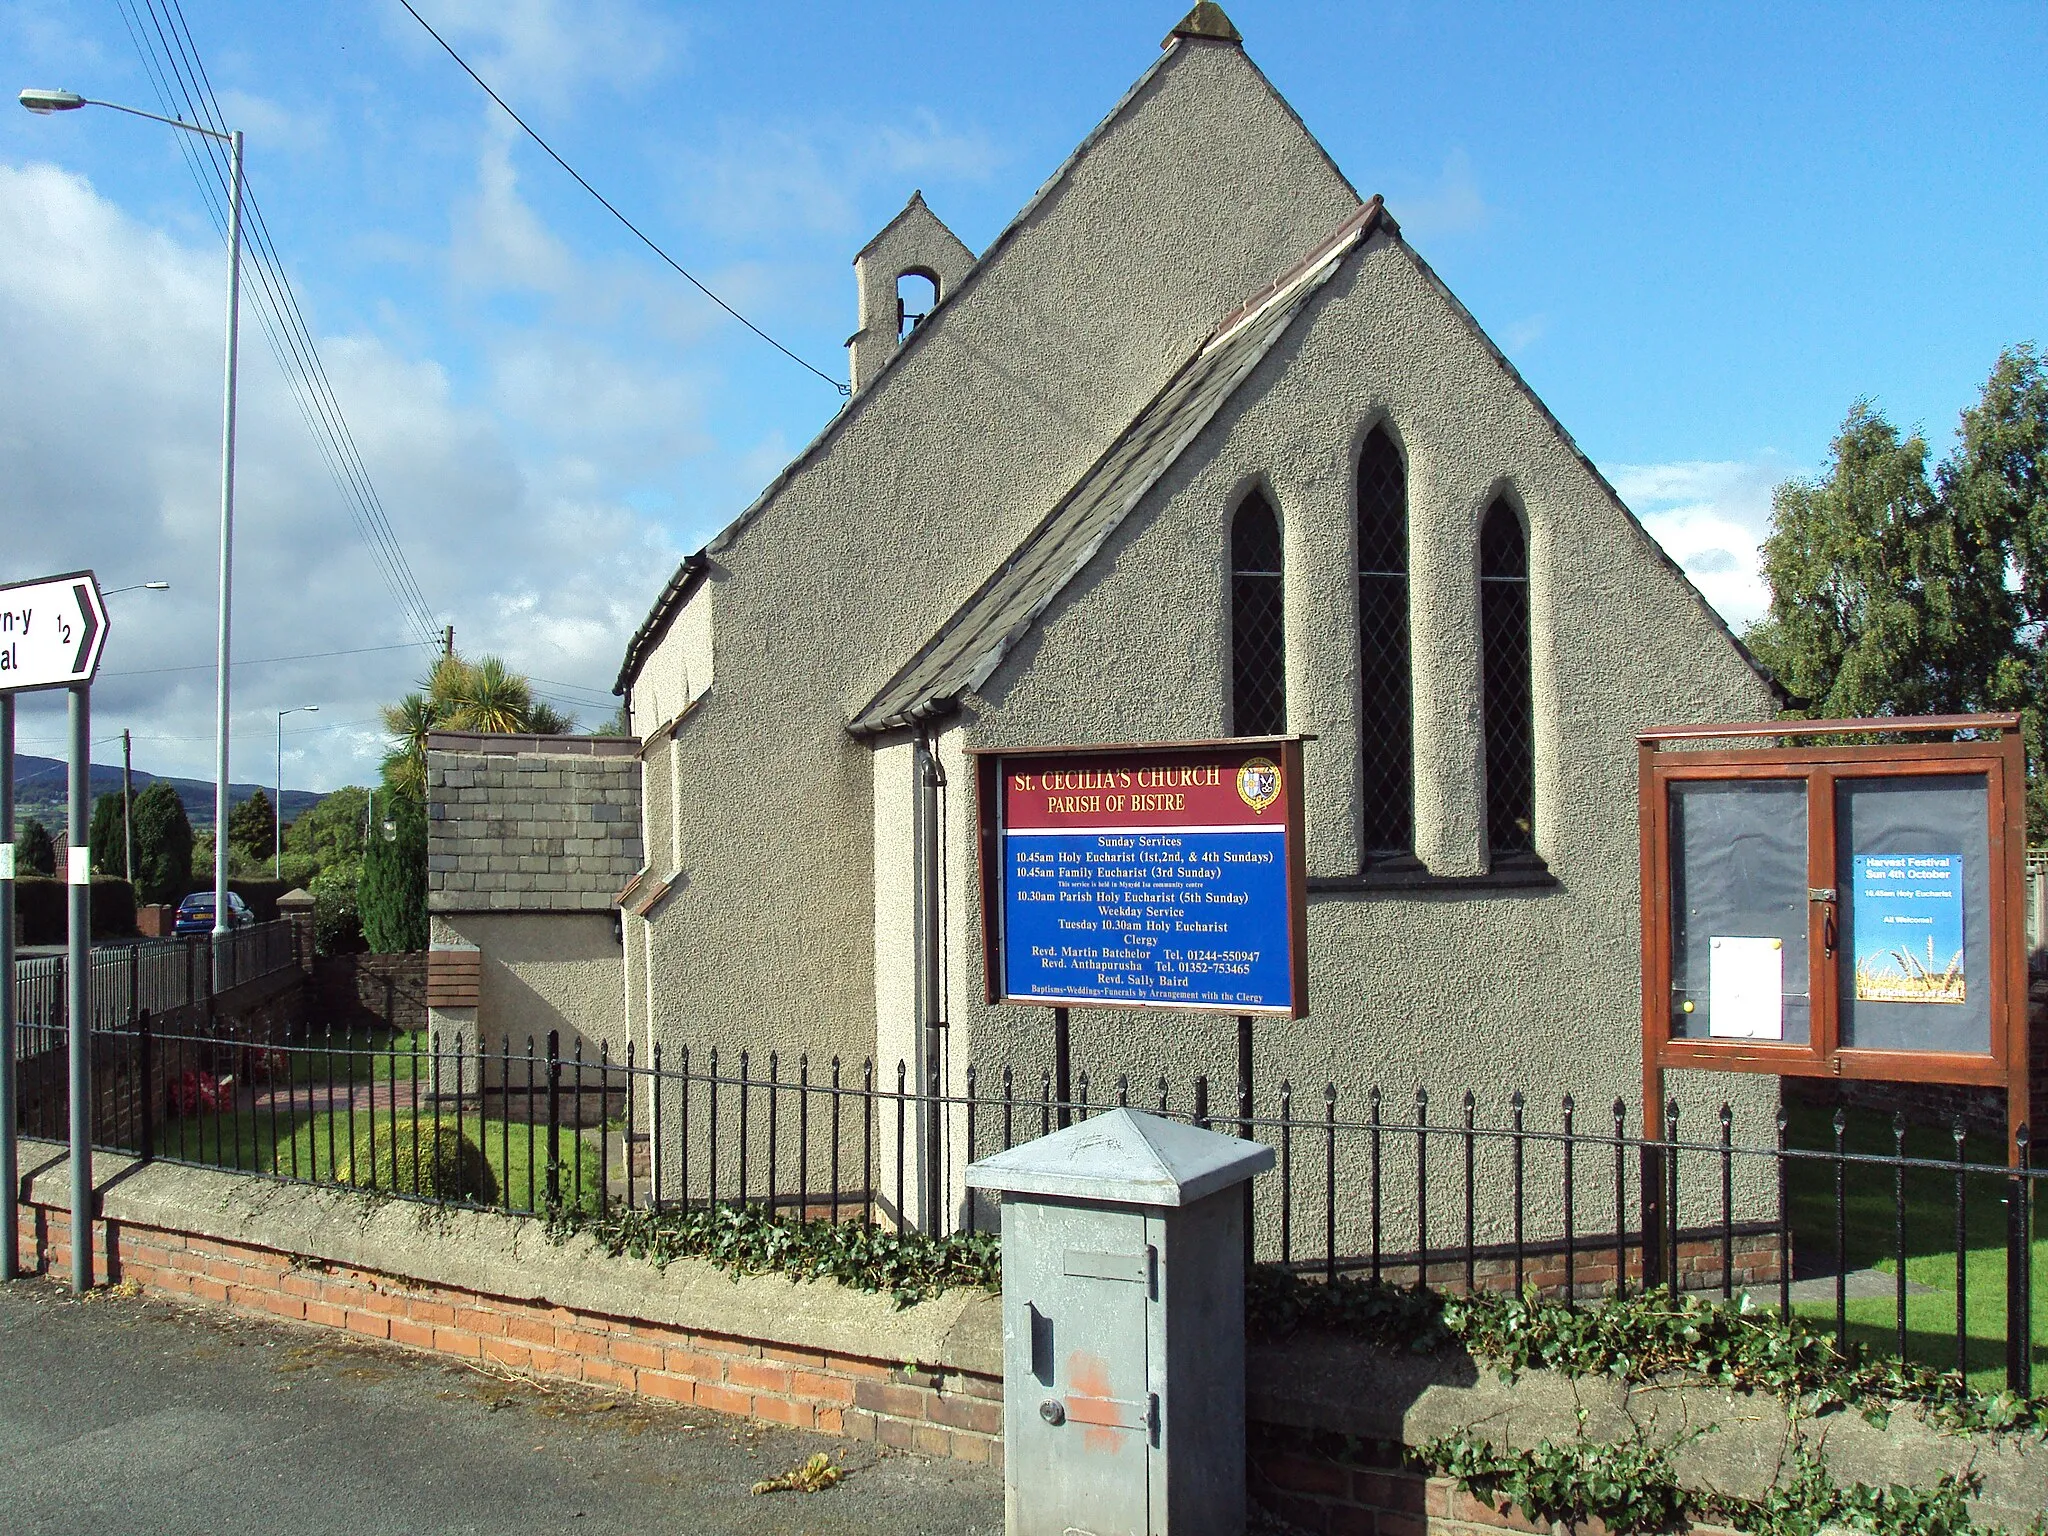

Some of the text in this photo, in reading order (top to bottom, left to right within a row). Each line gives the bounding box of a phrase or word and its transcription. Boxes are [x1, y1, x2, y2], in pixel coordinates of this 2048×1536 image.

[0, 608, 32, 636] n-y
[1015, 772, 1036, 791] St.
[1041, 768, 1131, 790] CECILIA'S
[1137, 765, 1221, 788] CHURCH
[1048, 793, 1185, 813] PARISH OF BISTRE
[1098, 835, 1182, 848] Sunday Services
[1016, 851, 1274, 864] 10.45am Holy Eucharist (1st,2nd, & 4th Sundays)
[1866, 858, 1950, 867] Harvest Festival
[1017, 866, 1222, 879] 10.45am Family Eucharist (3rd Sunday)
[1865, 870, 1951, 879] Sun 4th October
[1152, 881, 1184, 889] community
[1017, 891, 1249, 905] 10.30am Parish Holy Eucharist (5th Sunday)
[1098, 906, 1184, 918] Weekday Service
[1058, 919, 1228, 932] Tuesday 10.30am Holy Eucharist
[1124, 934, 1158, 946] Clergy
[1032, 946, 1260, 962] Revd. Martin Batchelor Tel. 01244-550947
[1041, 958, 1250, 974] Revd. Anthapurusha Tel. 01352-753465
[1098, 974, 1188, 987] Revd. Sally Baird
[1138, 988, 1147, 998] by
[1150, 989, 1198, 1000] Arrangement
[1202, 991, 1220, 1000] with
[1221, 991, 1234, 1001] the
[1236, 992, 1264, 1003] Clergy
